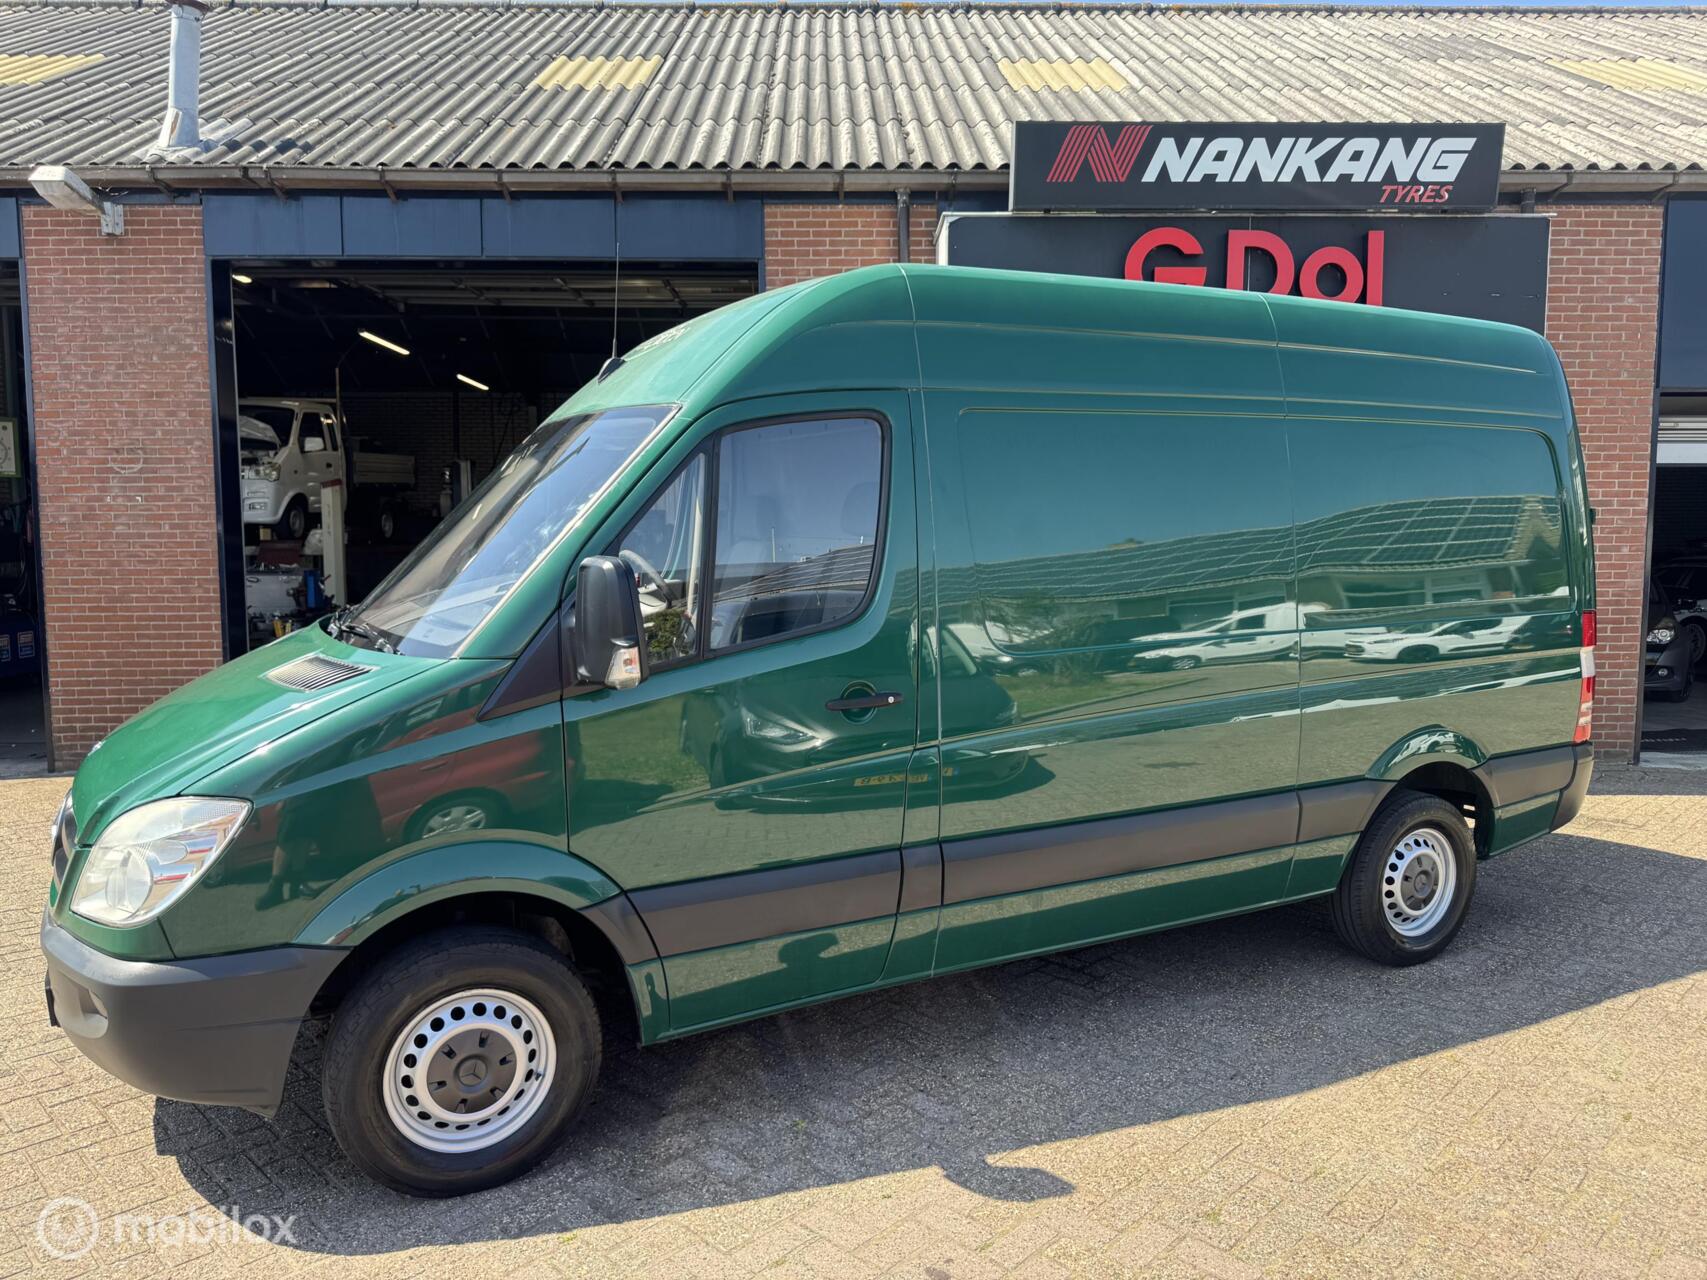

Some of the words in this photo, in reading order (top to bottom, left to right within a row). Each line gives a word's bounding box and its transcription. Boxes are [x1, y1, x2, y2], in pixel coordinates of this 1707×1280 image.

[1141, 137, 1477, 182] NANKANG
[1379, 184, 1454, 204] TYRES
[1124, 226, 1208, 287] G
[1226, 229, 1385, 306] Dol
